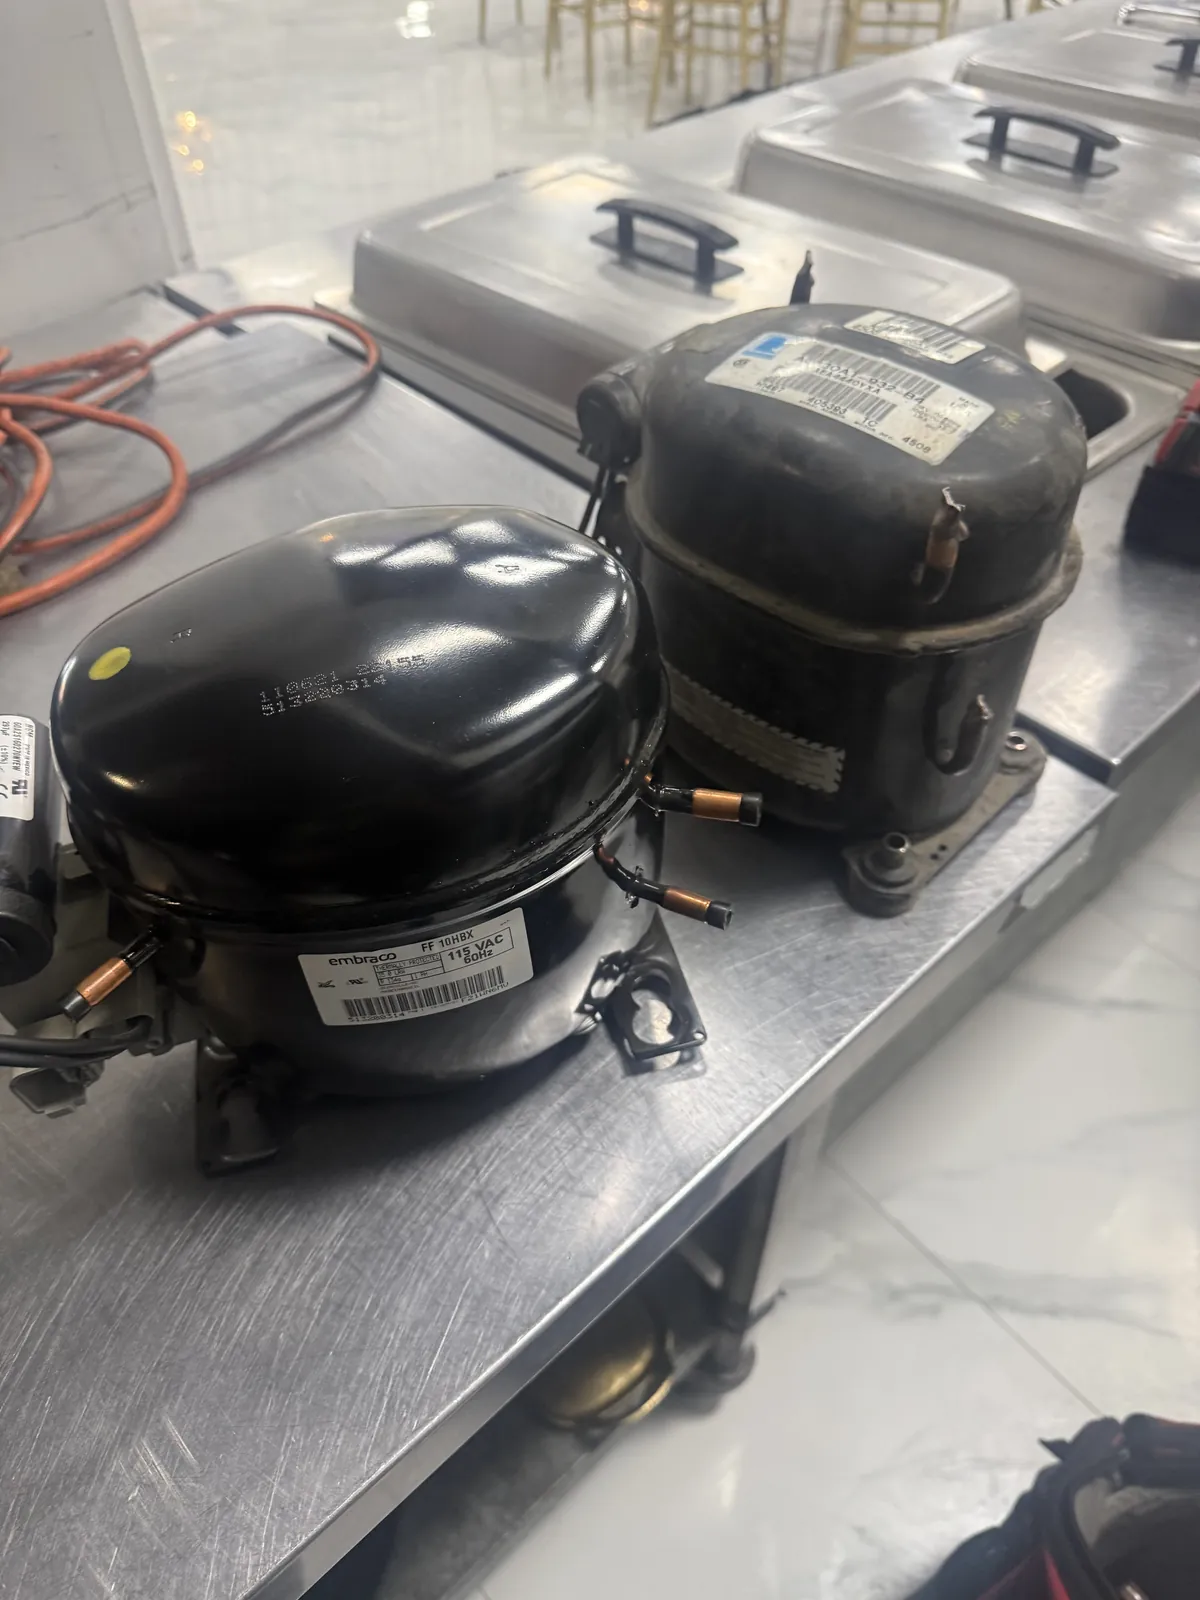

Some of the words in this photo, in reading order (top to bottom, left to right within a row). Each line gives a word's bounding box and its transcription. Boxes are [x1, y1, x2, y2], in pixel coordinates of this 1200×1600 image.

[421, 942, 435, 953] FF
[439, 929, 475, 949] 10HBX
[447, 946, 472, 962] 115
[474, 934, 504, 952] VAC
[328, 952, 397, 967] embraco
[463, 948, 495, 965] 60Hz
